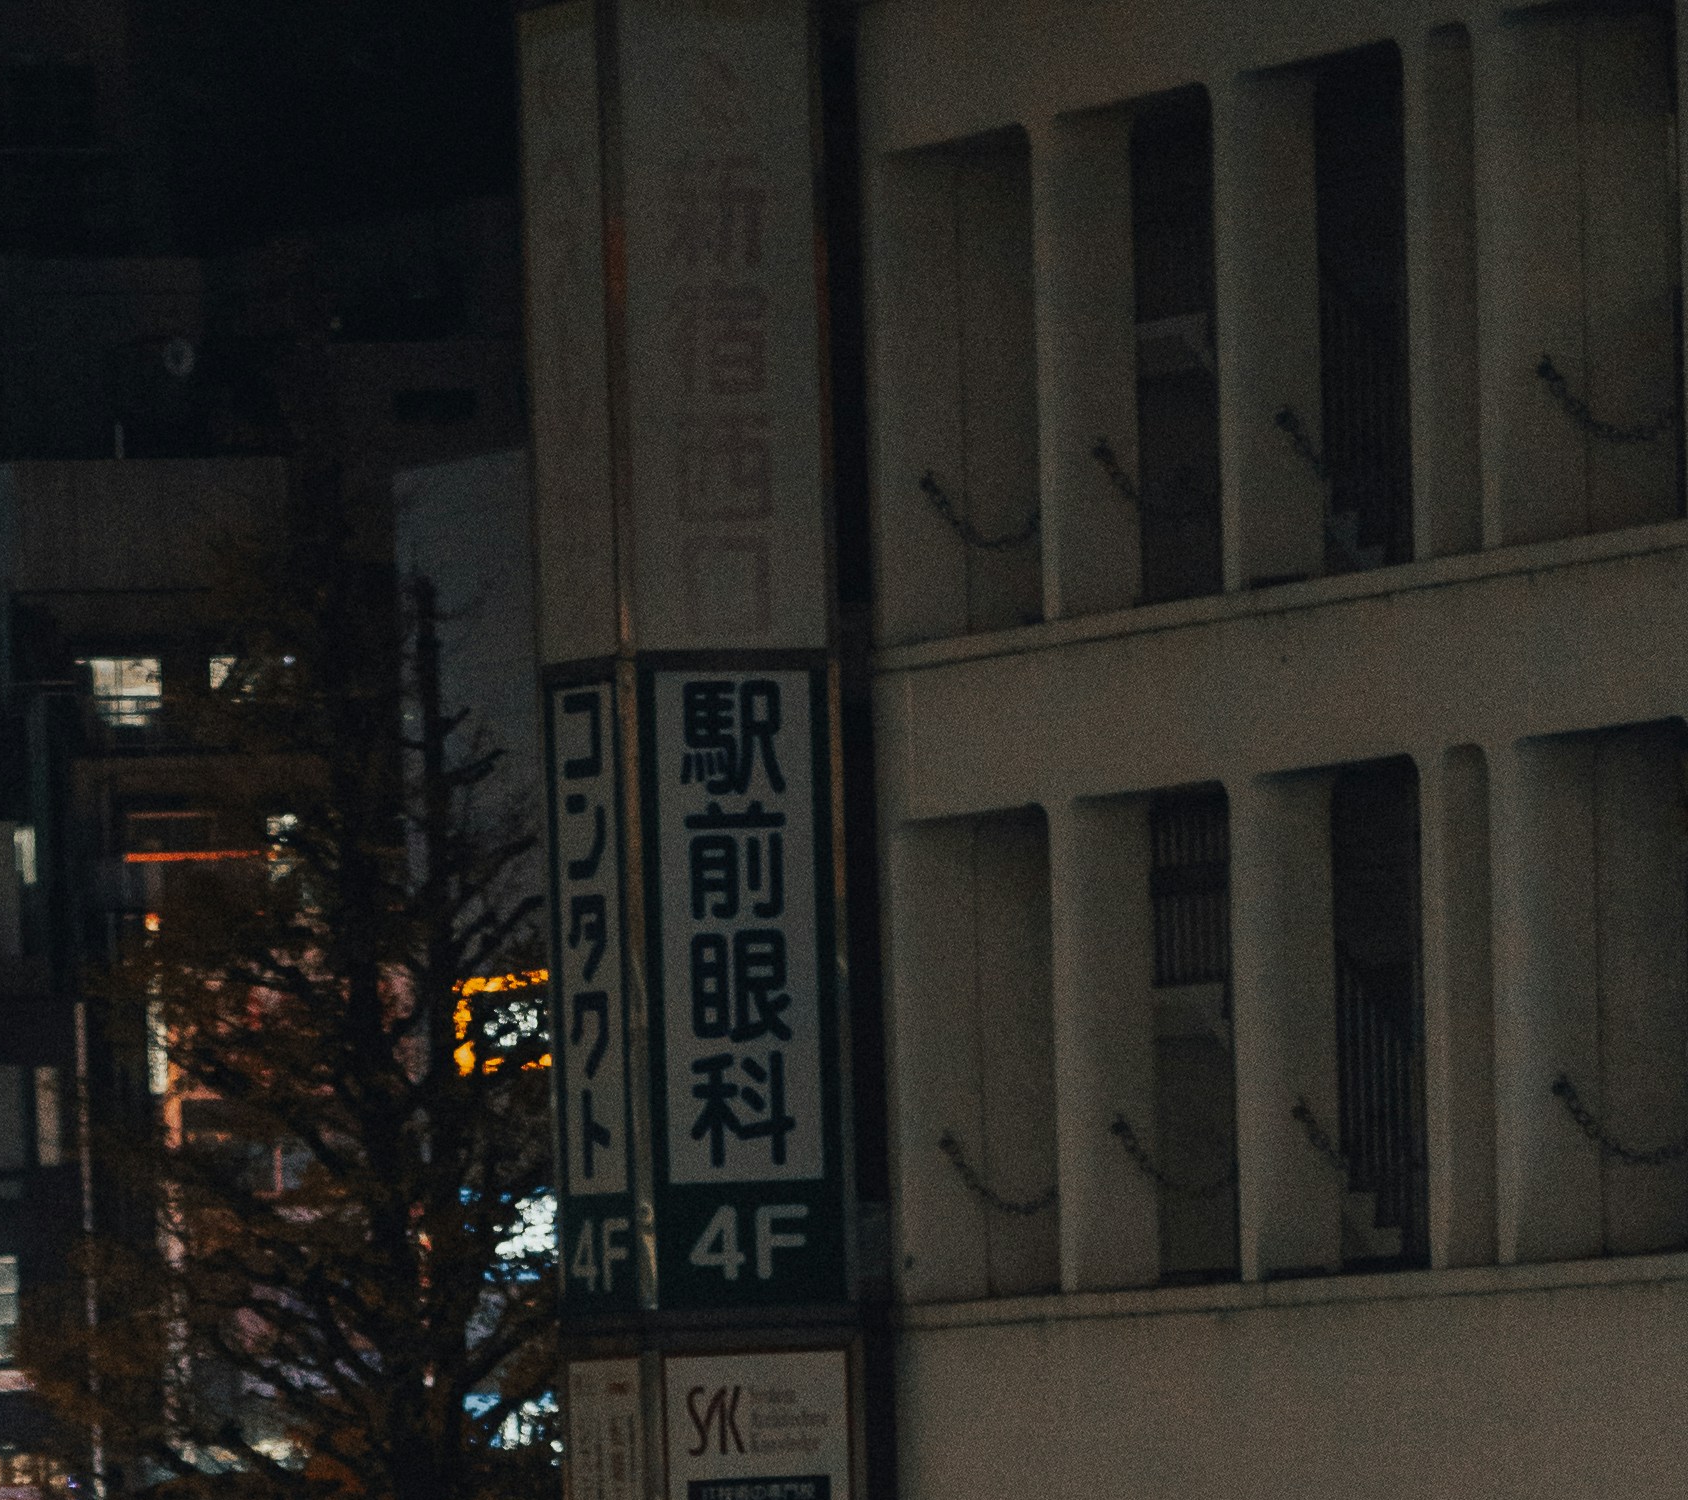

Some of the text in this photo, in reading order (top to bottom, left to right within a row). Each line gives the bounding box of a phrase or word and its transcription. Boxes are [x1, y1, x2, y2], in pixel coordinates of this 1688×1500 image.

[562, 691, 611, 1178] コンタクト
[679, 678, 796, 1169] 駅前眼科
[571, 1216, 631, 1294] 4F
[688, 1204, 808, 1281] 4F
